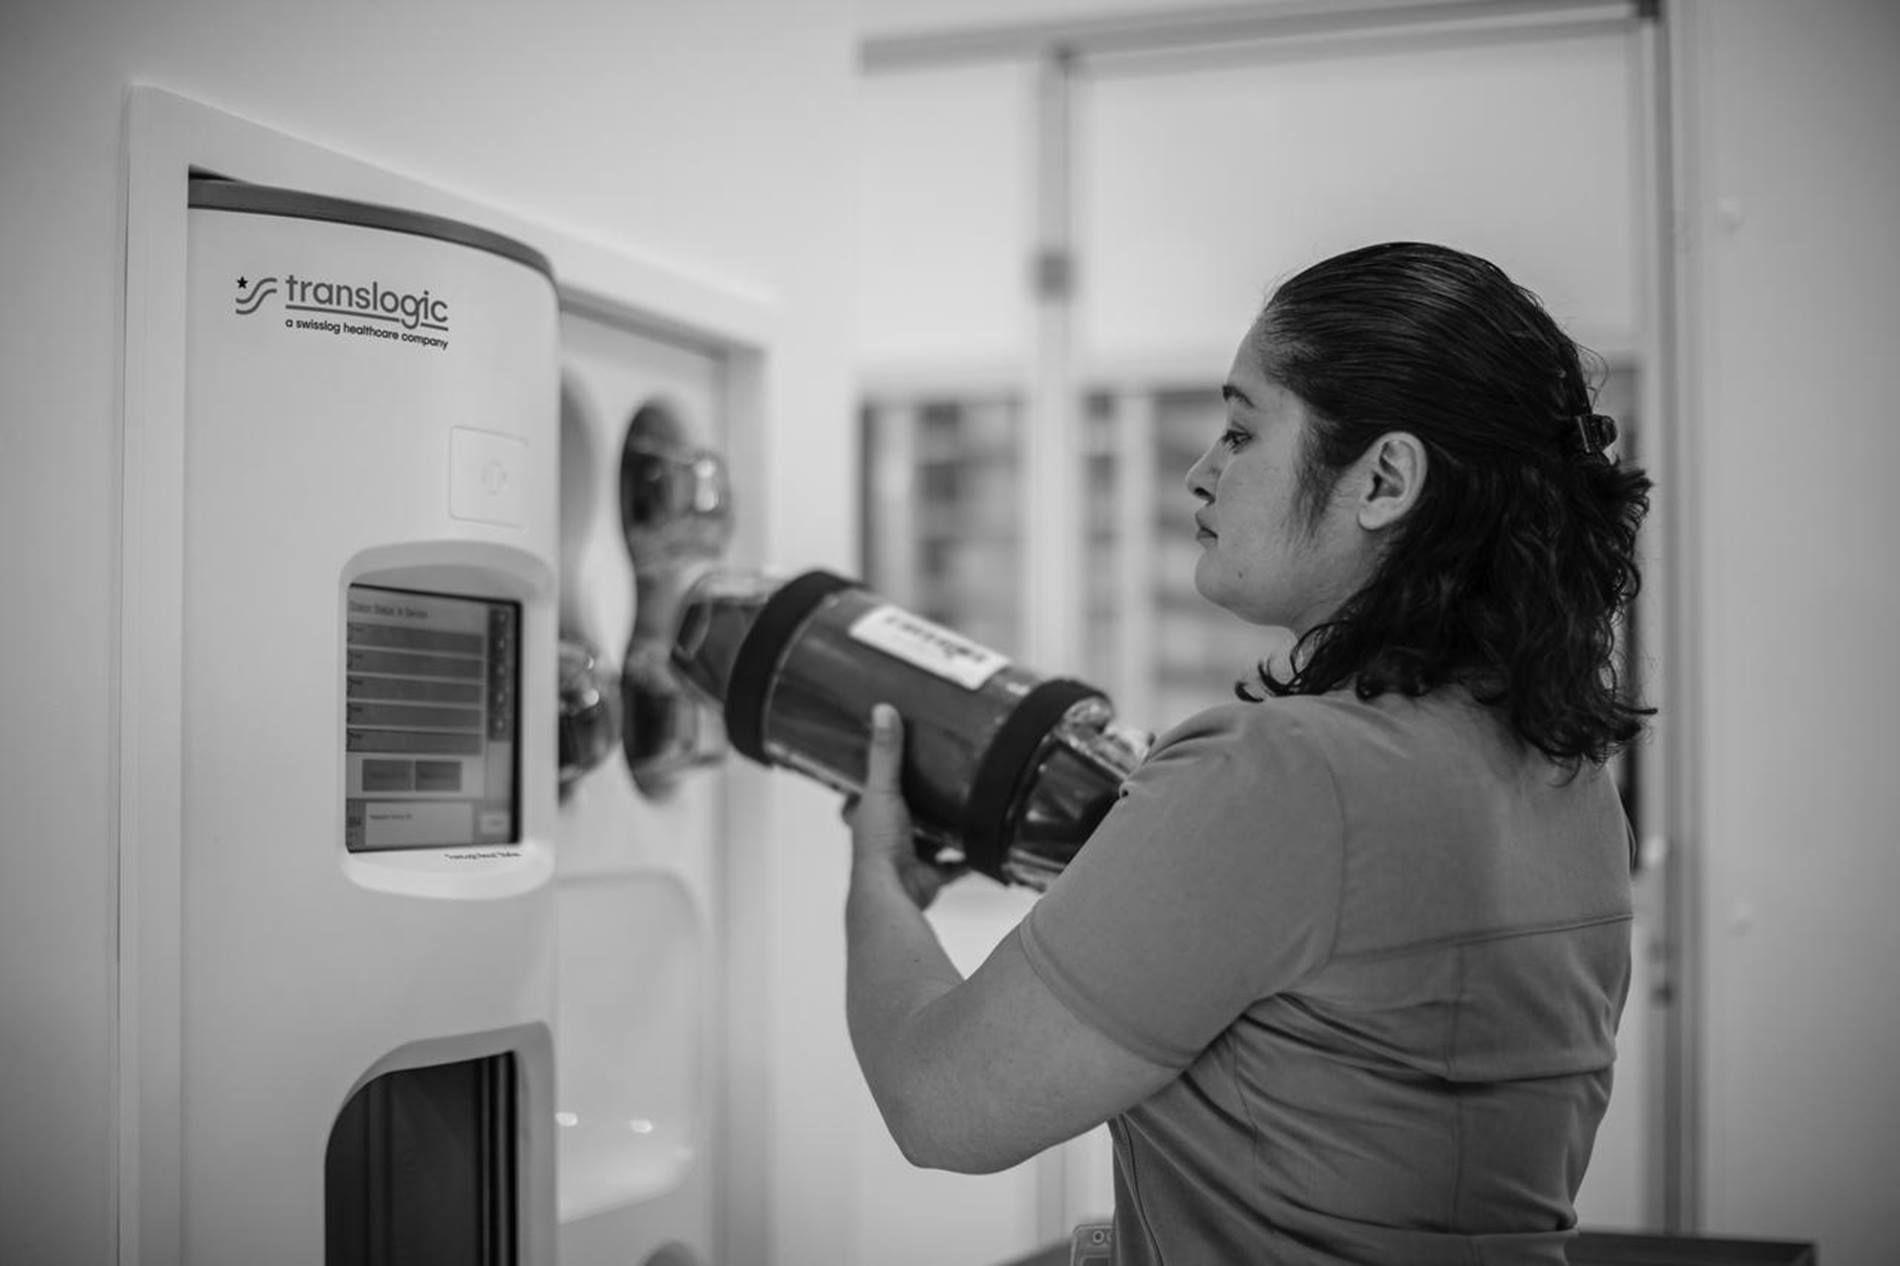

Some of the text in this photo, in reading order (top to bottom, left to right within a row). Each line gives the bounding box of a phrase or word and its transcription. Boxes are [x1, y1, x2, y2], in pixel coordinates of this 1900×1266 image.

[286, 275, 448, 329] translogic
[285, 319, 448, 350] a swisslog healthcare company
